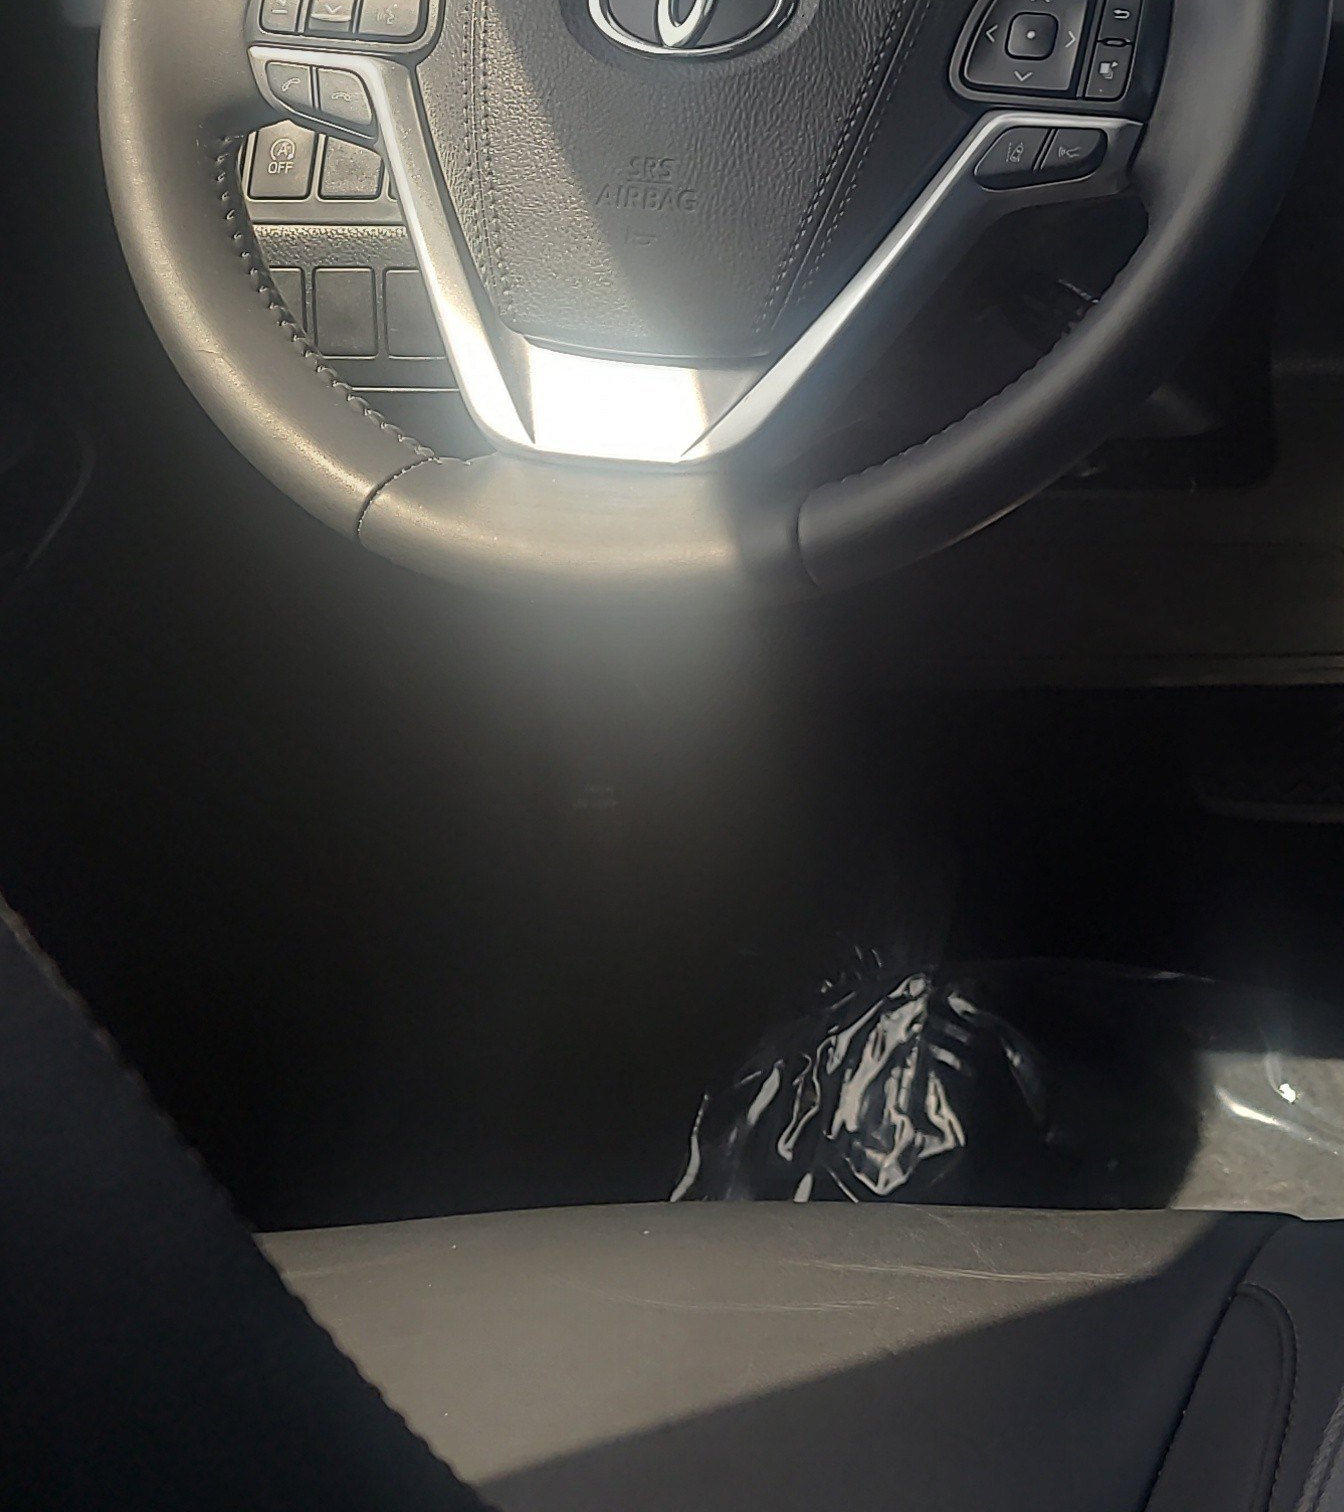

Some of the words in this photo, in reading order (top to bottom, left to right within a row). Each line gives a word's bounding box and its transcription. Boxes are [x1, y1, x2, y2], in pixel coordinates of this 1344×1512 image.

[268, 161, 295, 174] OFF
[627, 155, 676, 177] SRS
[596, 183, 698, 210] AIRBAG
